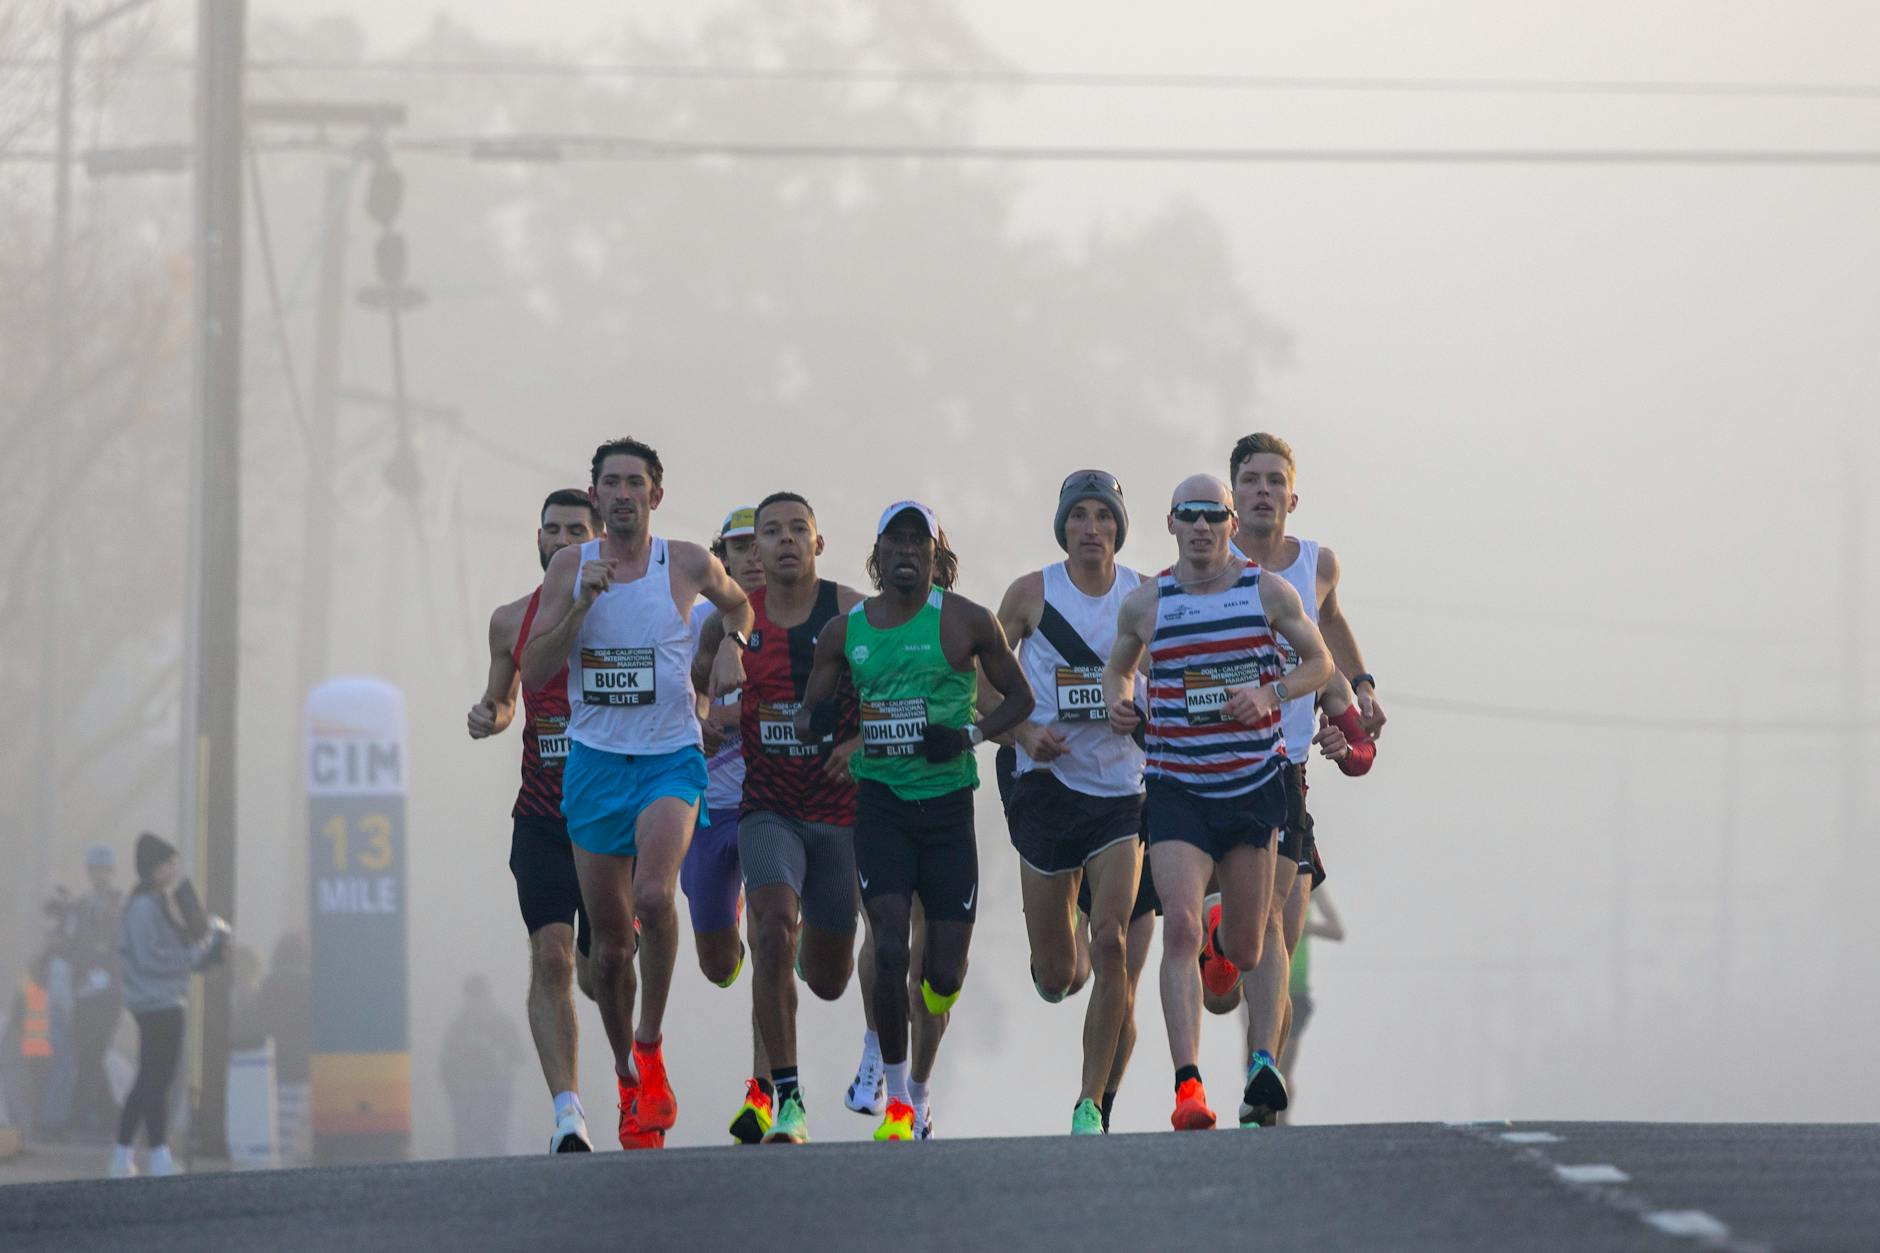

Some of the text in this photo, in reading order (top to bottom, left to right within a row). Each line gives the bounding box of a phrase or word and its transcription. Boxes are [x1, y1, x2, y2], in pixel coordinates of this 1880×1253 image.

[1222, 661, 1258, 673] CALIFORNIA
[1210, 667, 1258, 680] INTERNATIONAL
[1225, 673, 1259, 684] MARATHON
[595, 672, 638, 688] BUCK
[609, 694, 639, 704] ELITE
[889, 697, 925, 706] CALIFORNIA
[1069, 688, 1105, 705] CRO
[880, 703, 925, 713] INTERNATIONAL
[891, 709, 926, 719] MARATHON
[1089, 708, 1110, 719] ELI
[764, 725, 795, 740] JOR
[790, 745, 819, 756] ELITE
[887, 744, 915, 756] ELITE
[313, 742, 401, 787] CIM
[322, 815, 393, 871] 13
[318, 877, 397, 914] MILE
